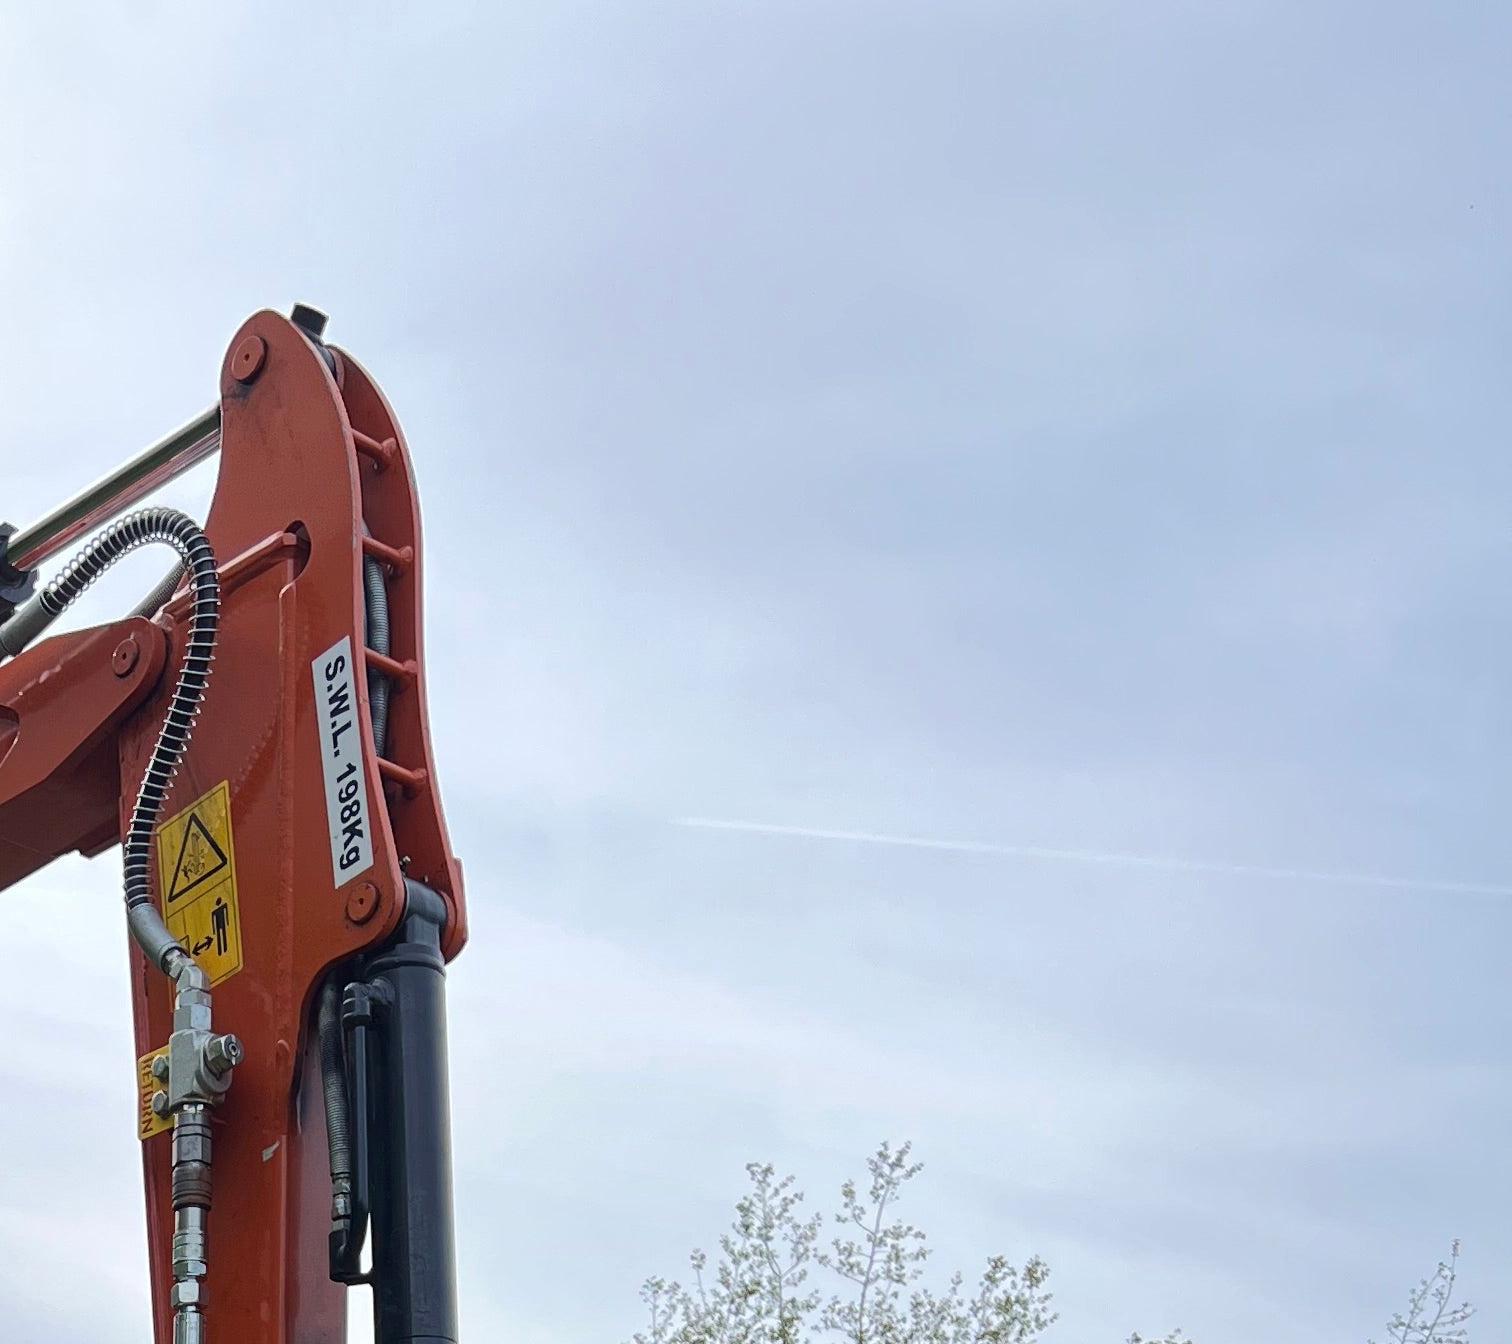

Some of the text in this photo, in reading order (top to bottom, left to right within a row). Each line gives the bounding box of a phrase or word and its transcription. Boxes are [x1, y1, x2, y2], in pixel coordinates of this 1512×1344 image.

[325, 656, 363, 870] S.W.L. 198Kg
[142, 1057, 154, 1134] RETURN
